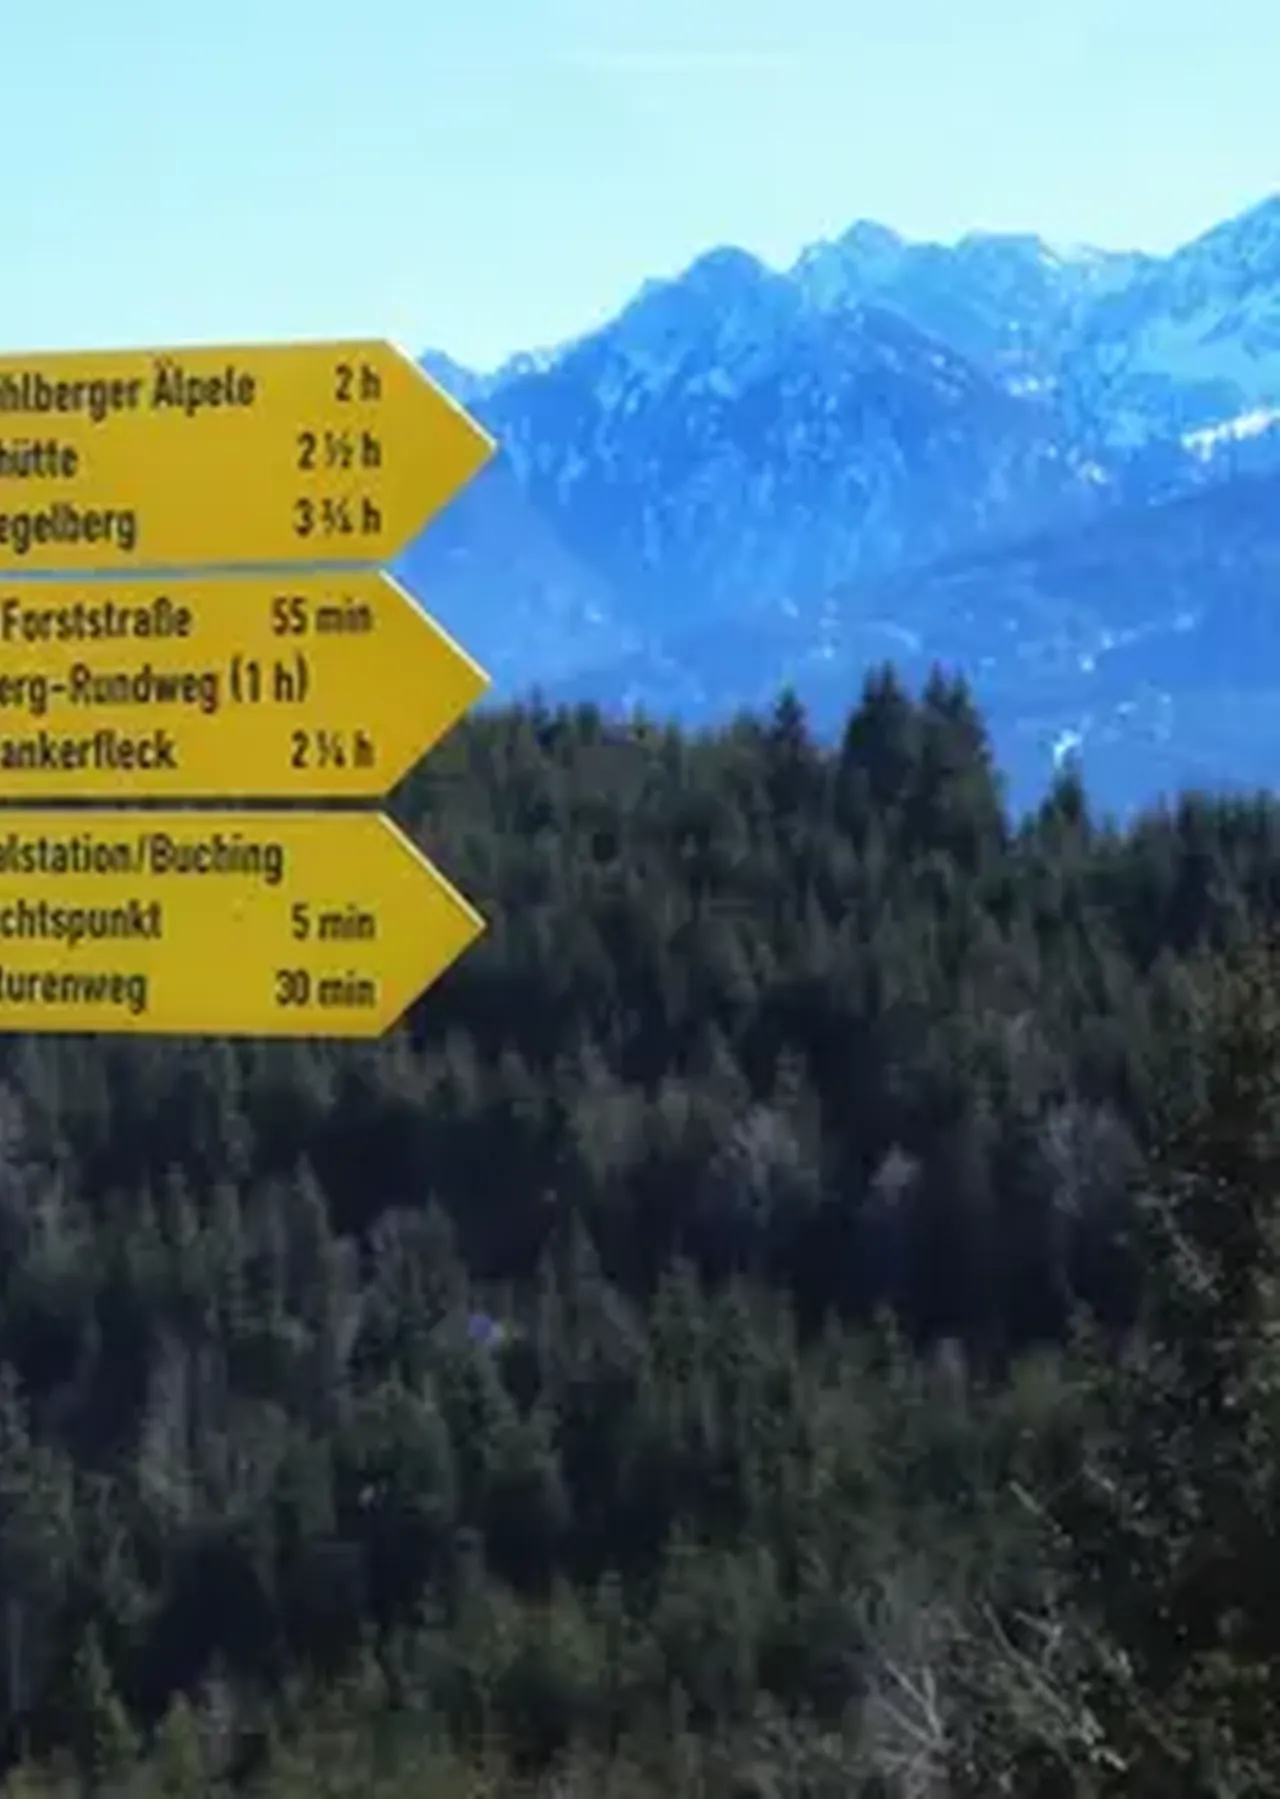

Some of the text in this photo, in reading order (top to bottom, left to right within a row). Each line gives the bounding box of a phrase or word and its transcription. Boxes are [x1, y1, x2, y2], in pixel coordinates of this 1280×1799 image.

[150, 362, 256, 414] Älpele
[359, 364, 381, 401] h
[361, 432, 381, 468] h
[361, 498, 382, 534] h
[272, 597, 373, 637] 55 min
[229, 659, 261, 703] (1
[274, 657, 309, 702] h)
[353, 731, 374, 767] h
[291, 902, 376, 941] 5 min
[275, 968, 375, 1007] 30 min
